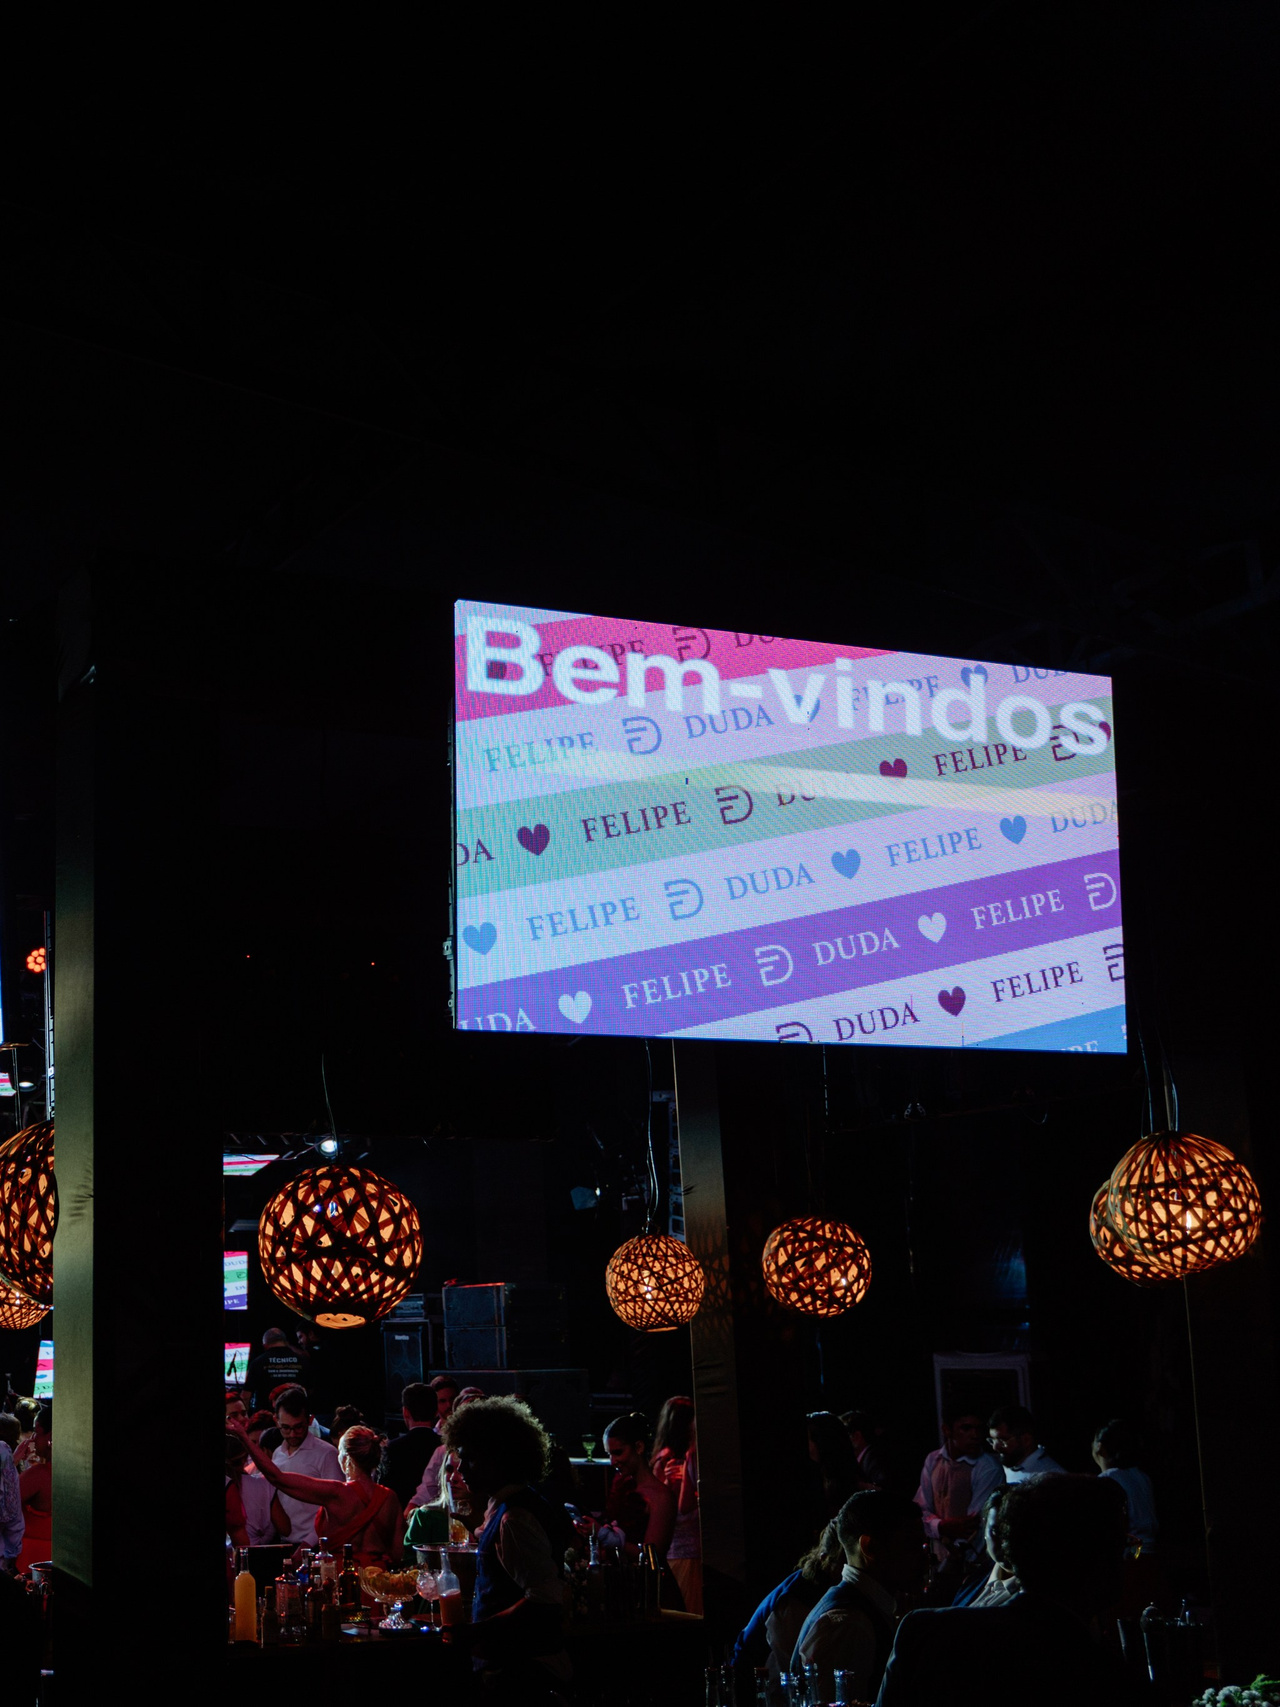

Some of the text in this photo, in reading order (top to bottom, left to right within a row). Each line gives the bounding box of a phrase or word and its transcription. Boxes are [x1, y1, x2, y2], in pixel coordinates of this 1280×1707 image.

[467, 614, 1109, 756] Bem-vindos
[683, 704, 774, 739] DUDA
[581, 801, 691, 843] FELIPE
[933, 743, 1028, 777] FELIPE
[526, 897, 641, 941] FELIPE
[724, 862, 816, 901] DUDA
[885, 828, 982, 867] FELIPE
[621, 963, 731, 1009] FELIPE
[812, 927, 900, 966] DUDA
[970, 889, 1065, 929] FELIPE
[833, 1001, 920, 1041] DUDA
[991, 961, 1084, 1003] FELIPE
